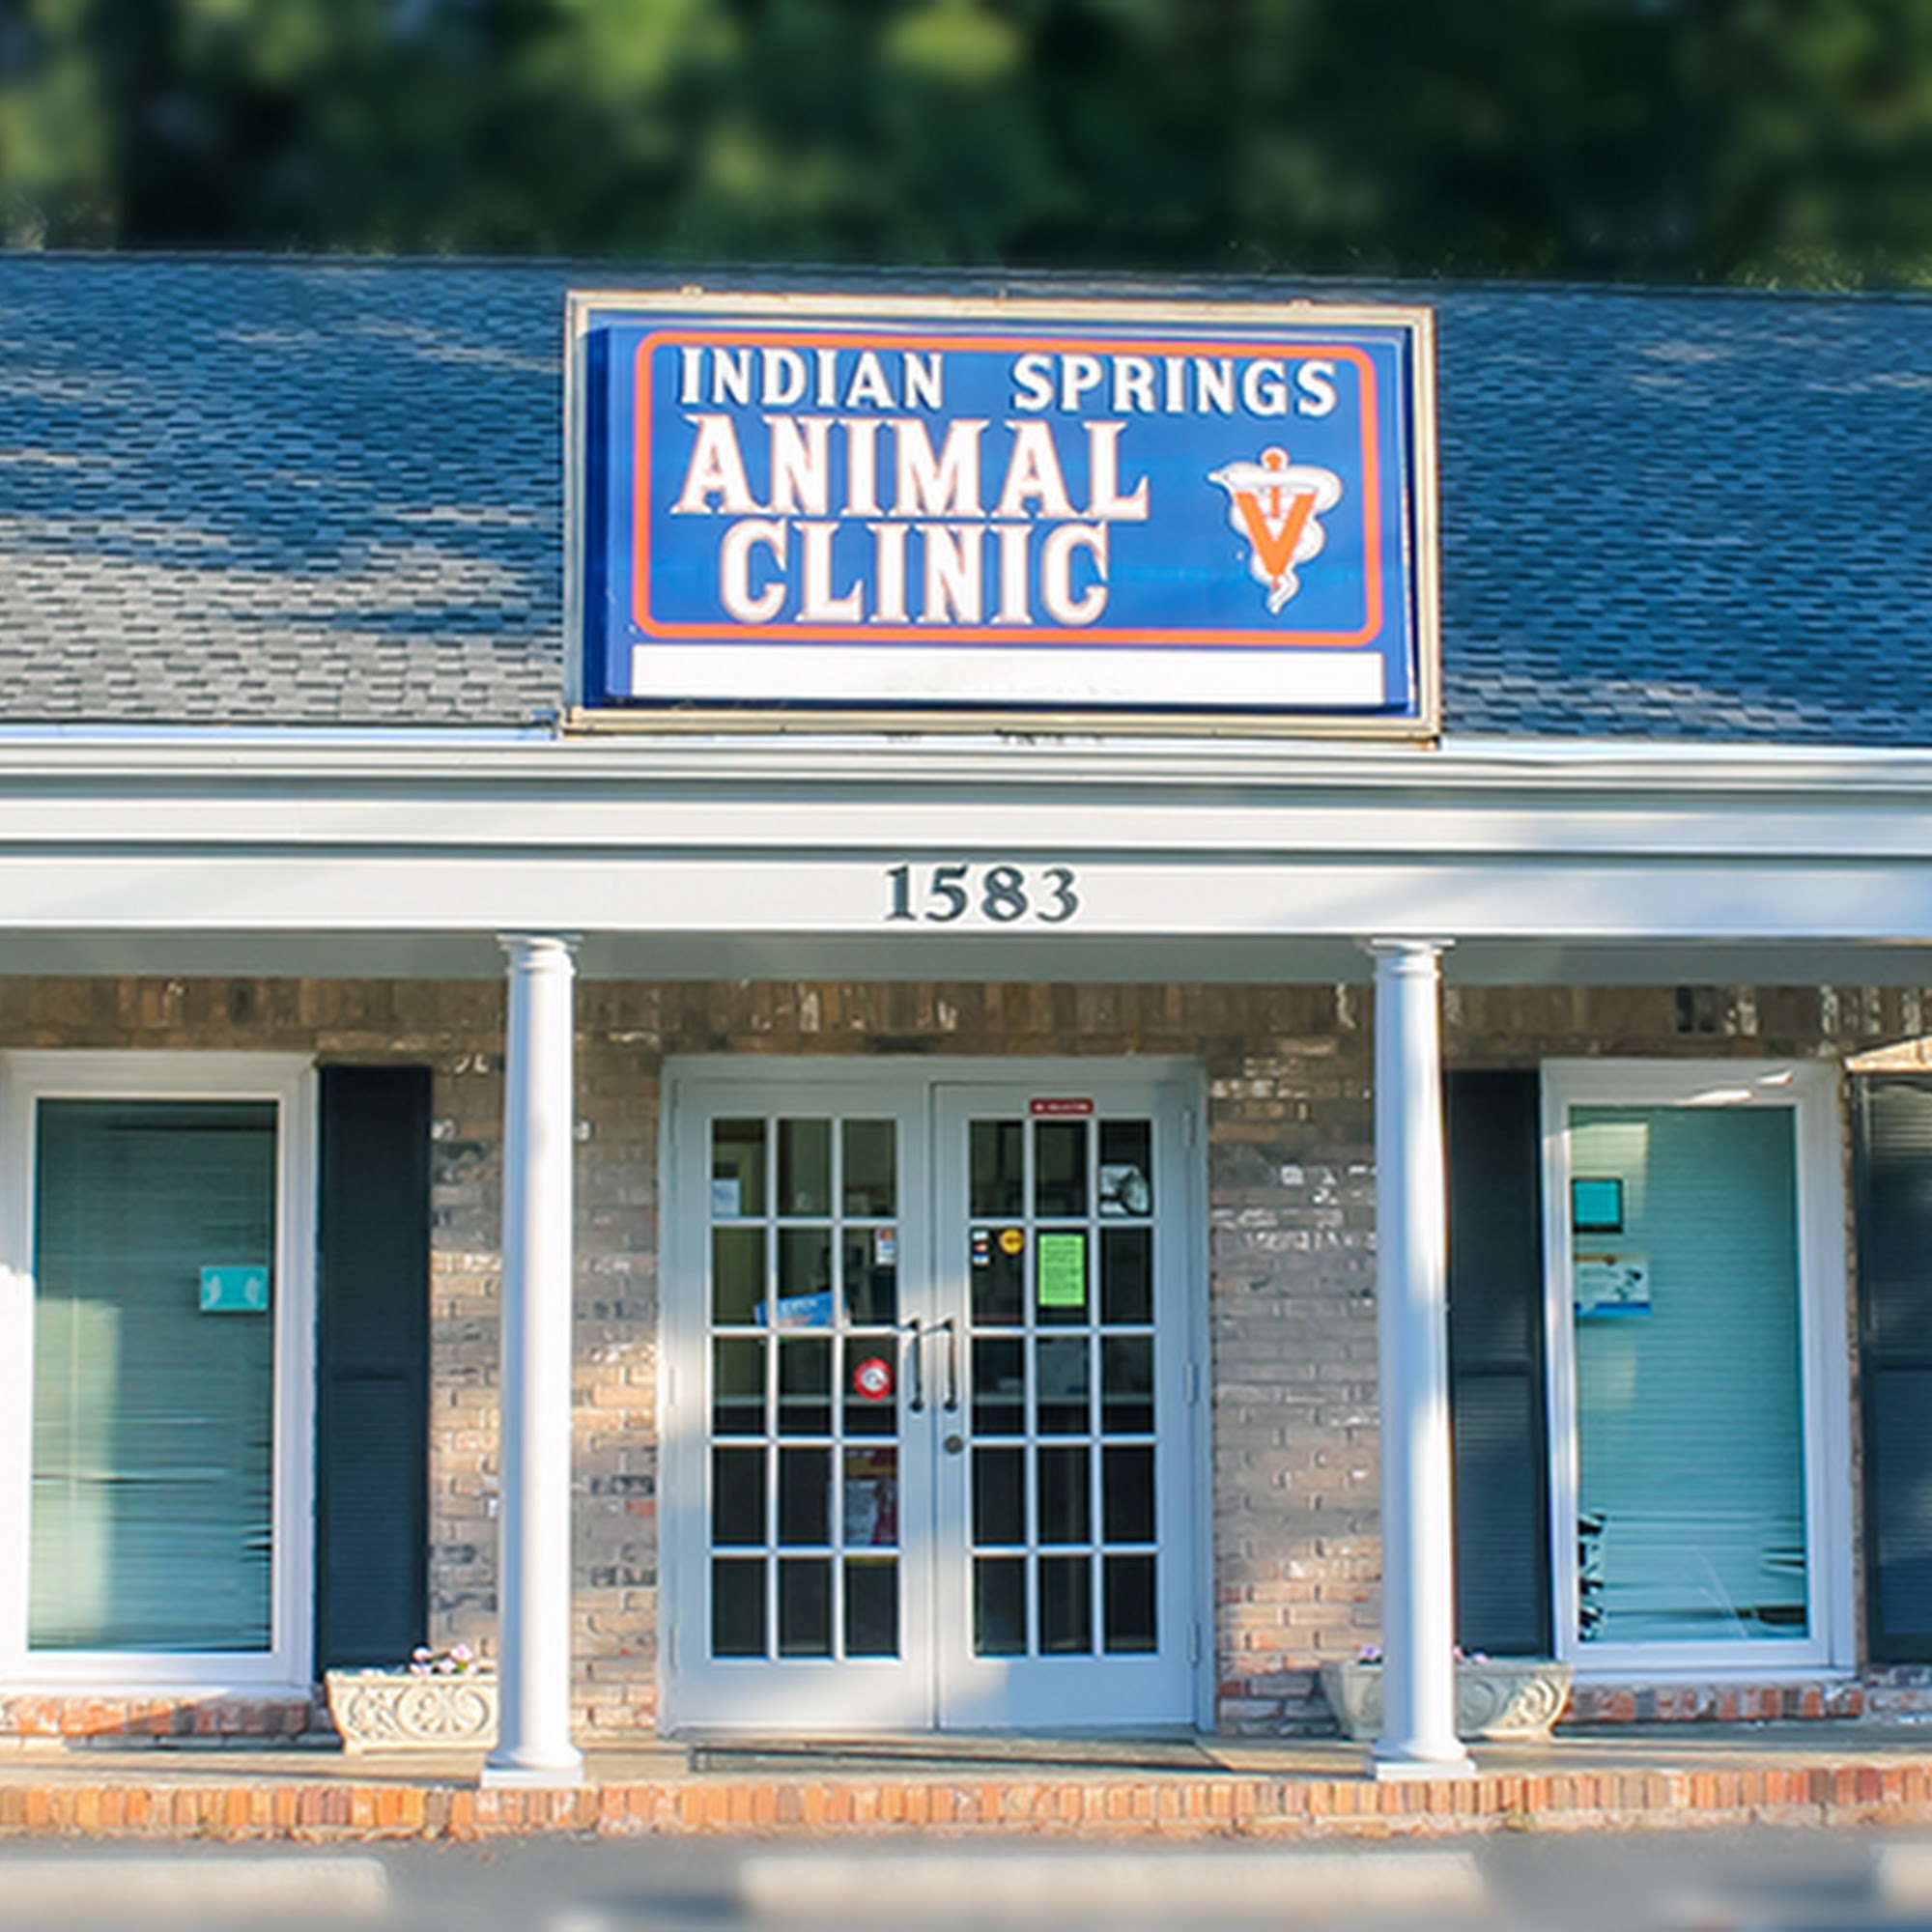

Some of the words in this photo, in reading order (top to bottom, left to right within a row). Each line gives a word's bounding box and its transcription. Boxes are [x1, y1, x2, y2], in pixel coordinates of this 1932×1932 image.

[679, 347, 944, 409] INDIAN
[1012, 353, 1339, 416] SPRINGS
[669, 413, 1150, 521] ANIMAL
[720, 517, 1110, 626] CLINIC
[884, 865, 1079, 923] 1583
